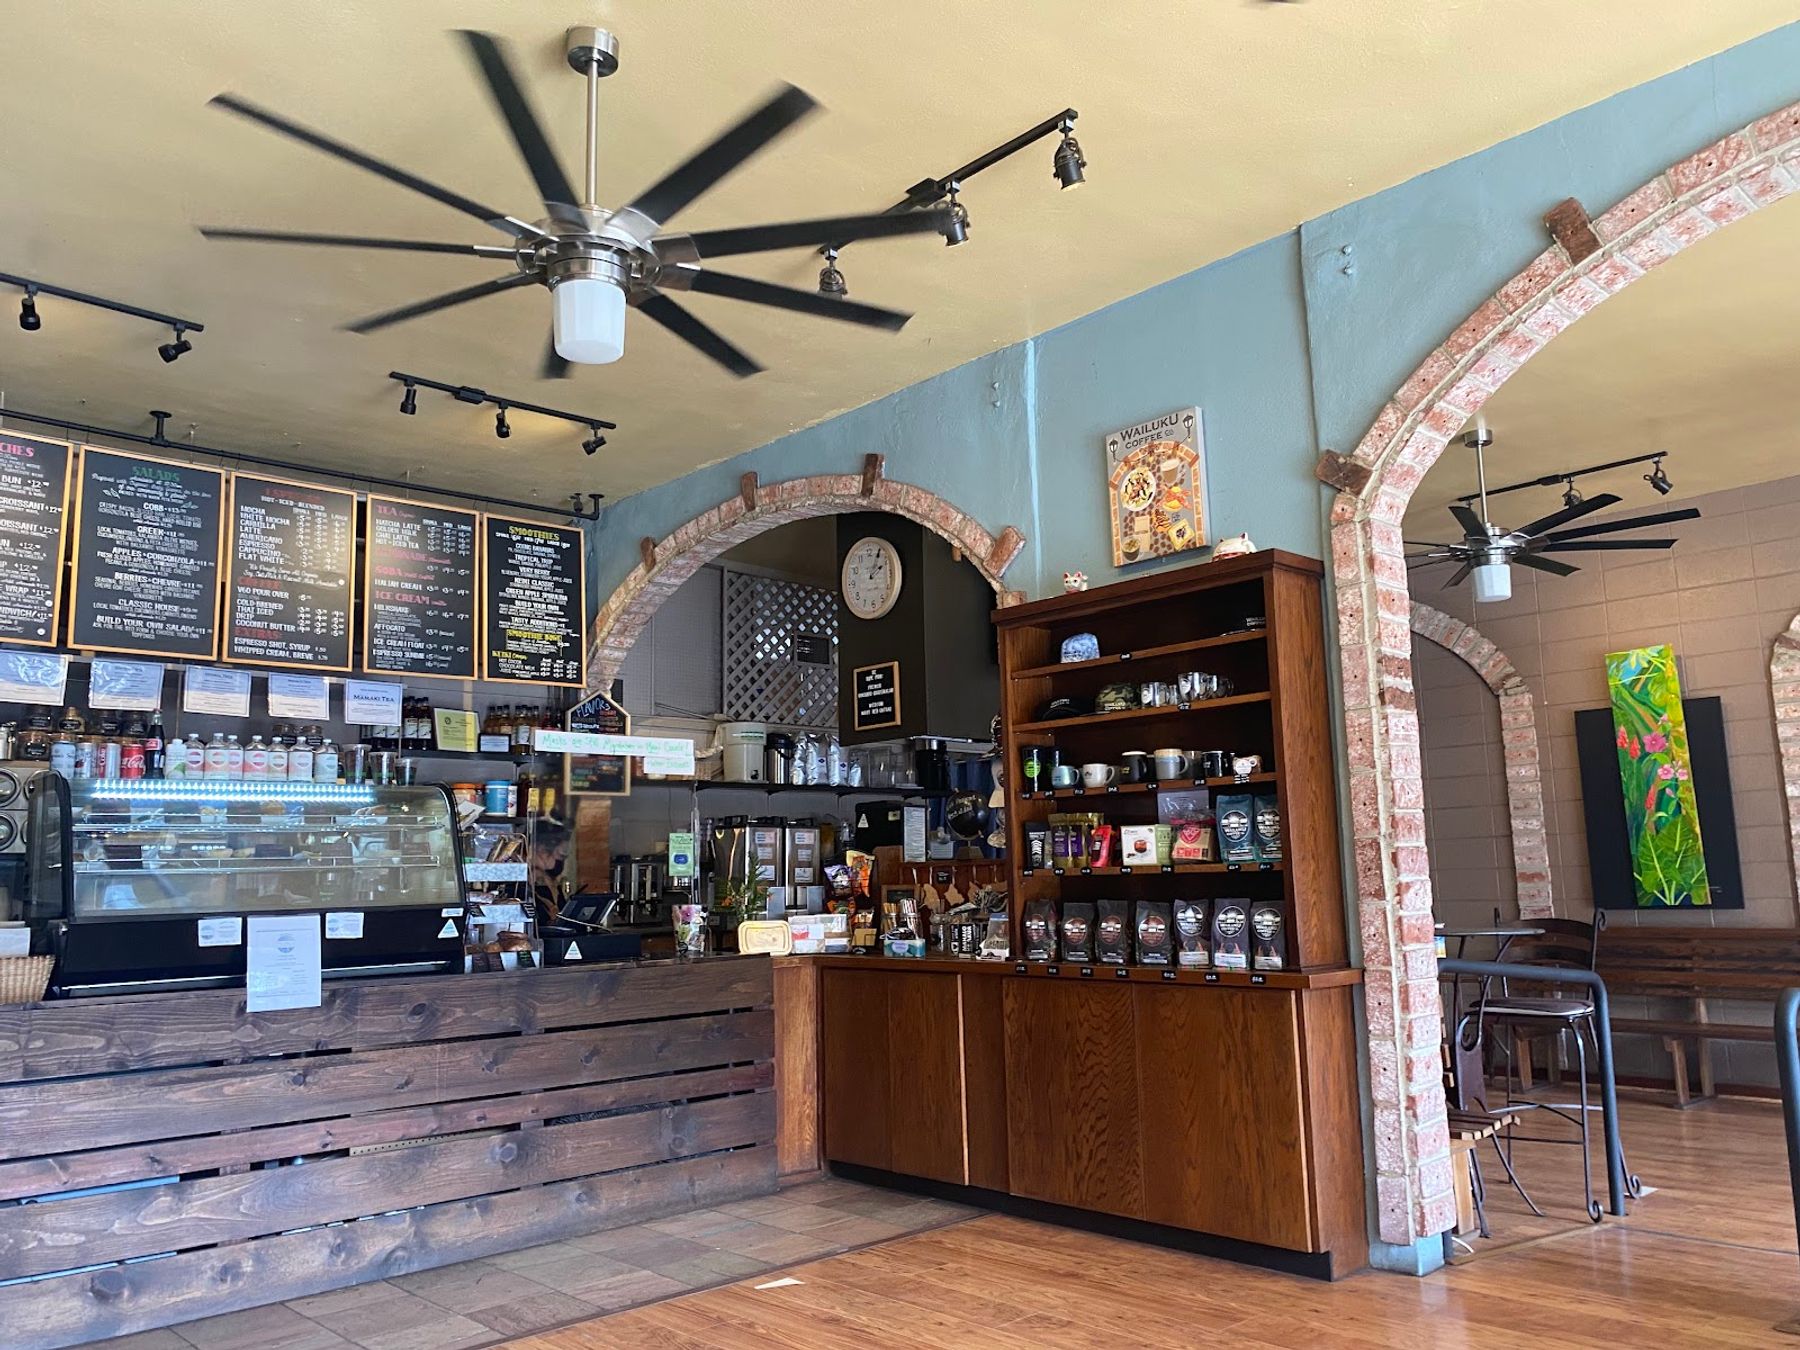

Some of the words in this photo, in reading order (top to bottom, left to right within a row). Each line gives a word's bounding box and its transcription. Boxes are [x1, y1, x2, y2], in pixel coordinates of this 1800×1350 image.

[1120, 413, 1179, 442] WAILUKU
[1125, 431, 1163, 449] COFFEE
[2, 474, 21, 484] BUN
[132, 466, 180, 482] SALADS
[143, 502, 163, 511] COBB
[240, 505, 265, 515] MOCHA
[377, 505, 397, 515] TEA
[240, 512, 263, 521] WHITE
[265, 516, 289, 525] MOCHA
[375, 518, 399, 527] MATCHA
[402, 522, 421, 530] LATTE
[375, 525, 398, 533] GOLDEN
[137, 525, 163, 535] GREEK
[240, 526, 261, 534] LATTE
[508, 526, 559, 540] SMOOTHIES
[239, 532, 282, 544] AMERICANO
[239, 539, 274, 549] ESPRESSO
[112, 546, 142, 556] APPLES
[260, 555, 284, 564] WHITE
[515, 554, 539, 562] TROPICAL
[375, 565, 401, 576] SODA
[114, 572, 146, 582] BERRIES
[152, 577, 181, 587] CHEVRE
[374, 578, 398, 587] ITALIAN
[400, 582, 421, 590] CREAM
[531, 579, 554, 587] CLASSIC
[5, 584, 28, 593] WRAP
[252, 588, 270, 596] POUR
[271, 591, 289, 599] OVER
[376, 590, 390, 599] ICE
[395, 593, 429, 604] CREAM
[118, 598, 153, 608] CLASSIC
[155, 602, 179, 612] HOUSE
[236, 612, 254, 620] DRIP
[96, 615, 120, 624] BUILD
[122, 618, 143, 627] YOUR
[146, 621, 163, 629] OWN
[235, 619, 267, 628] COCONUT
[270, 622, 295, 631] BUTTER
[373, 623, 405, 632] AFFOGATO
[508, 630, 541, 638] SMOOTHIE
[234, 637, 267, 646] ESPRESSO
[289, 643, 310, 651] SYRUP
[386, 639, 405, 647] CREAM
[234, 645, 264, 655] WHIPPED
[373, 648, 402, 657] ESPRESSO
[380, 696, 394, 704] TEA
[576, 698, 611, 718] FLAVORS
